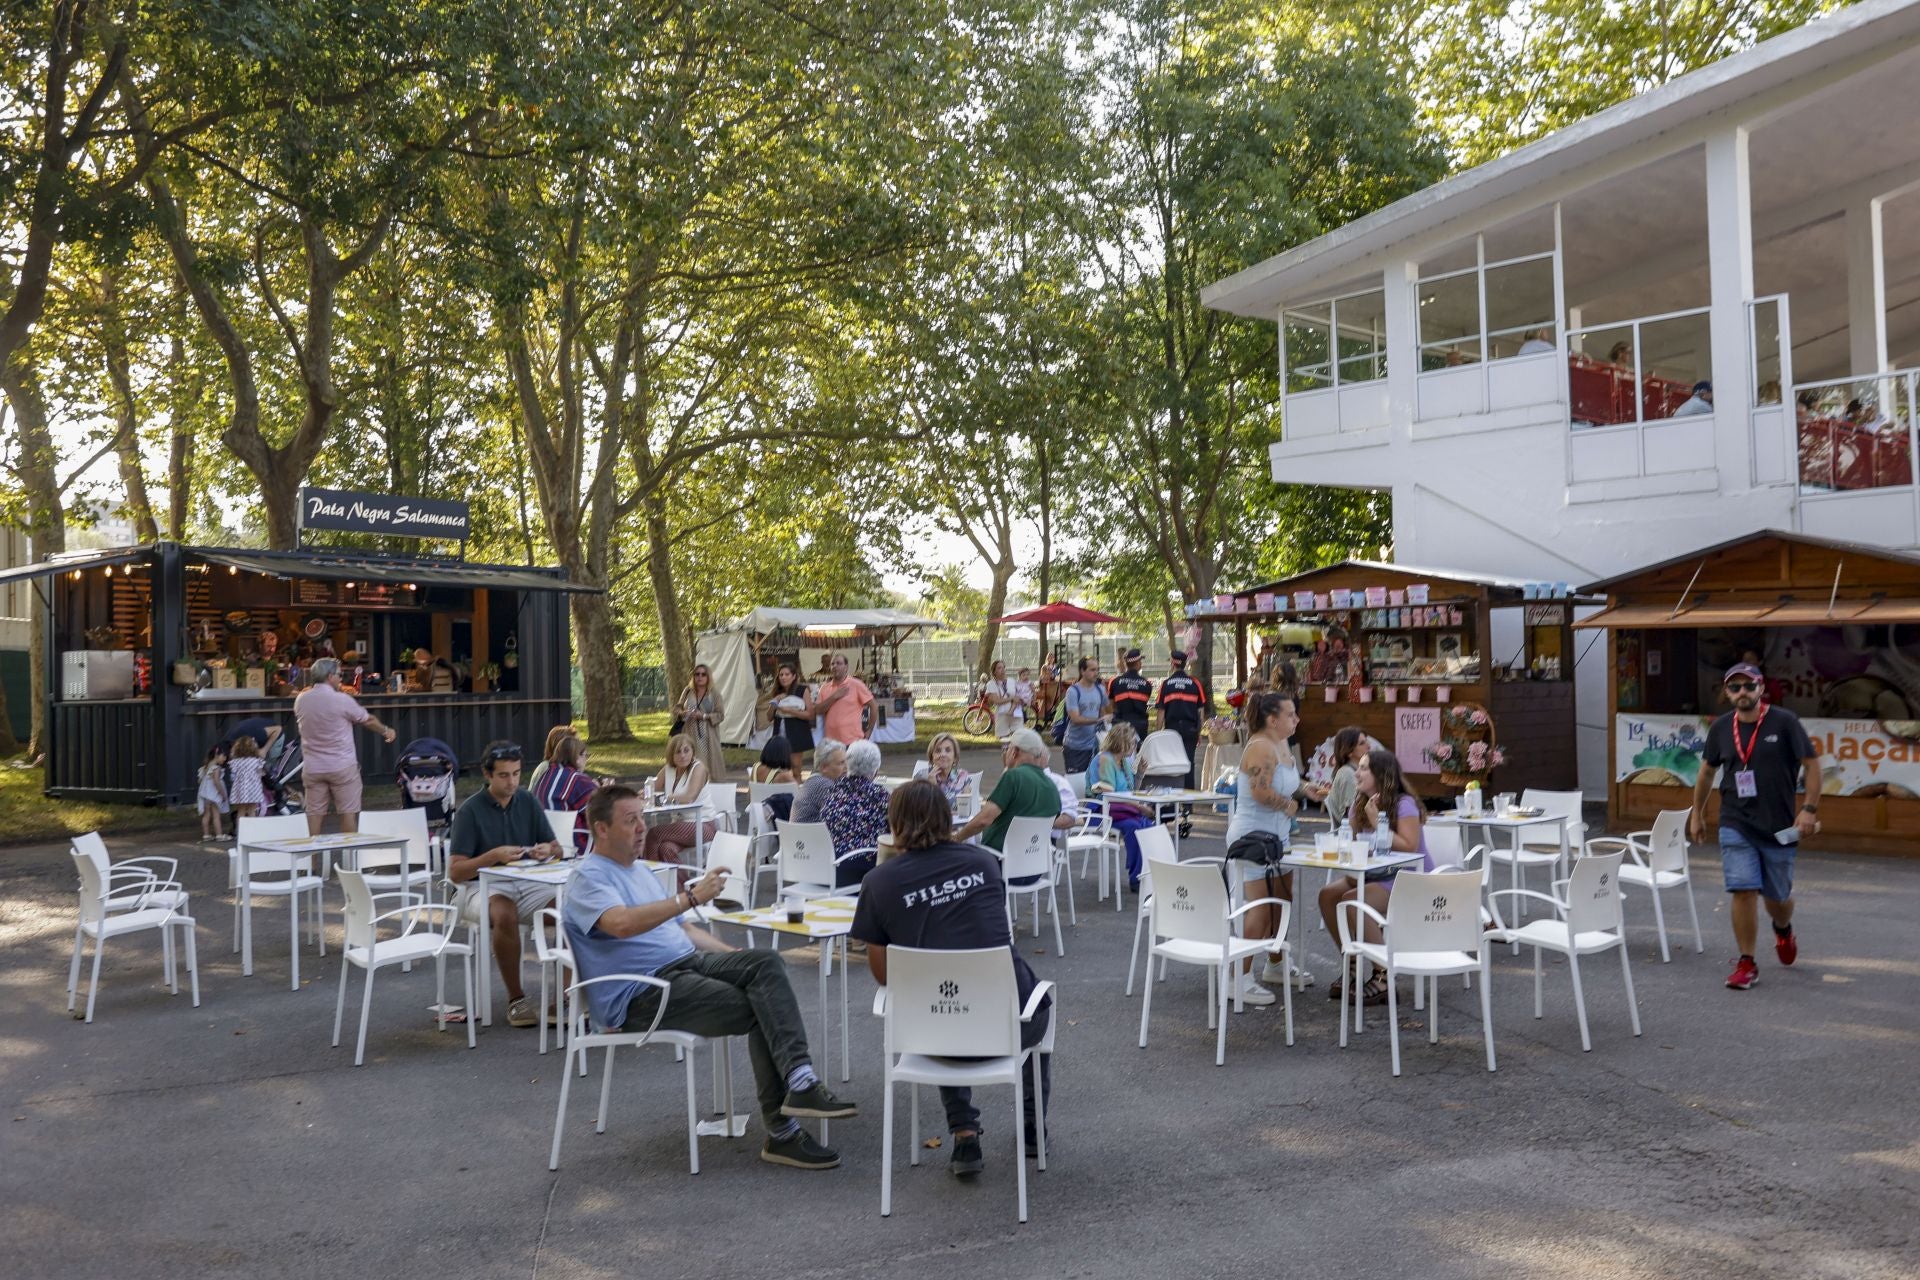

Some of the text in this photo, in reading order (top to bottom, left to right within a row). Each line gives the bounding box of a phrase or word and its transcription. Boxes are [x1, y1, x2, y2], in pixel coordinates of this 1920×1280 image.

[308, 497, 466, 527] Pata Negra Salamanca
[1401, 711, 1432, 730] CREPES
[1628, 722, 1645, 741] La
[903, 872, 985, 908] FILSON
[930, 895, 951, 907] SINCE
[931, 1004, 970, 1014] BLISS
